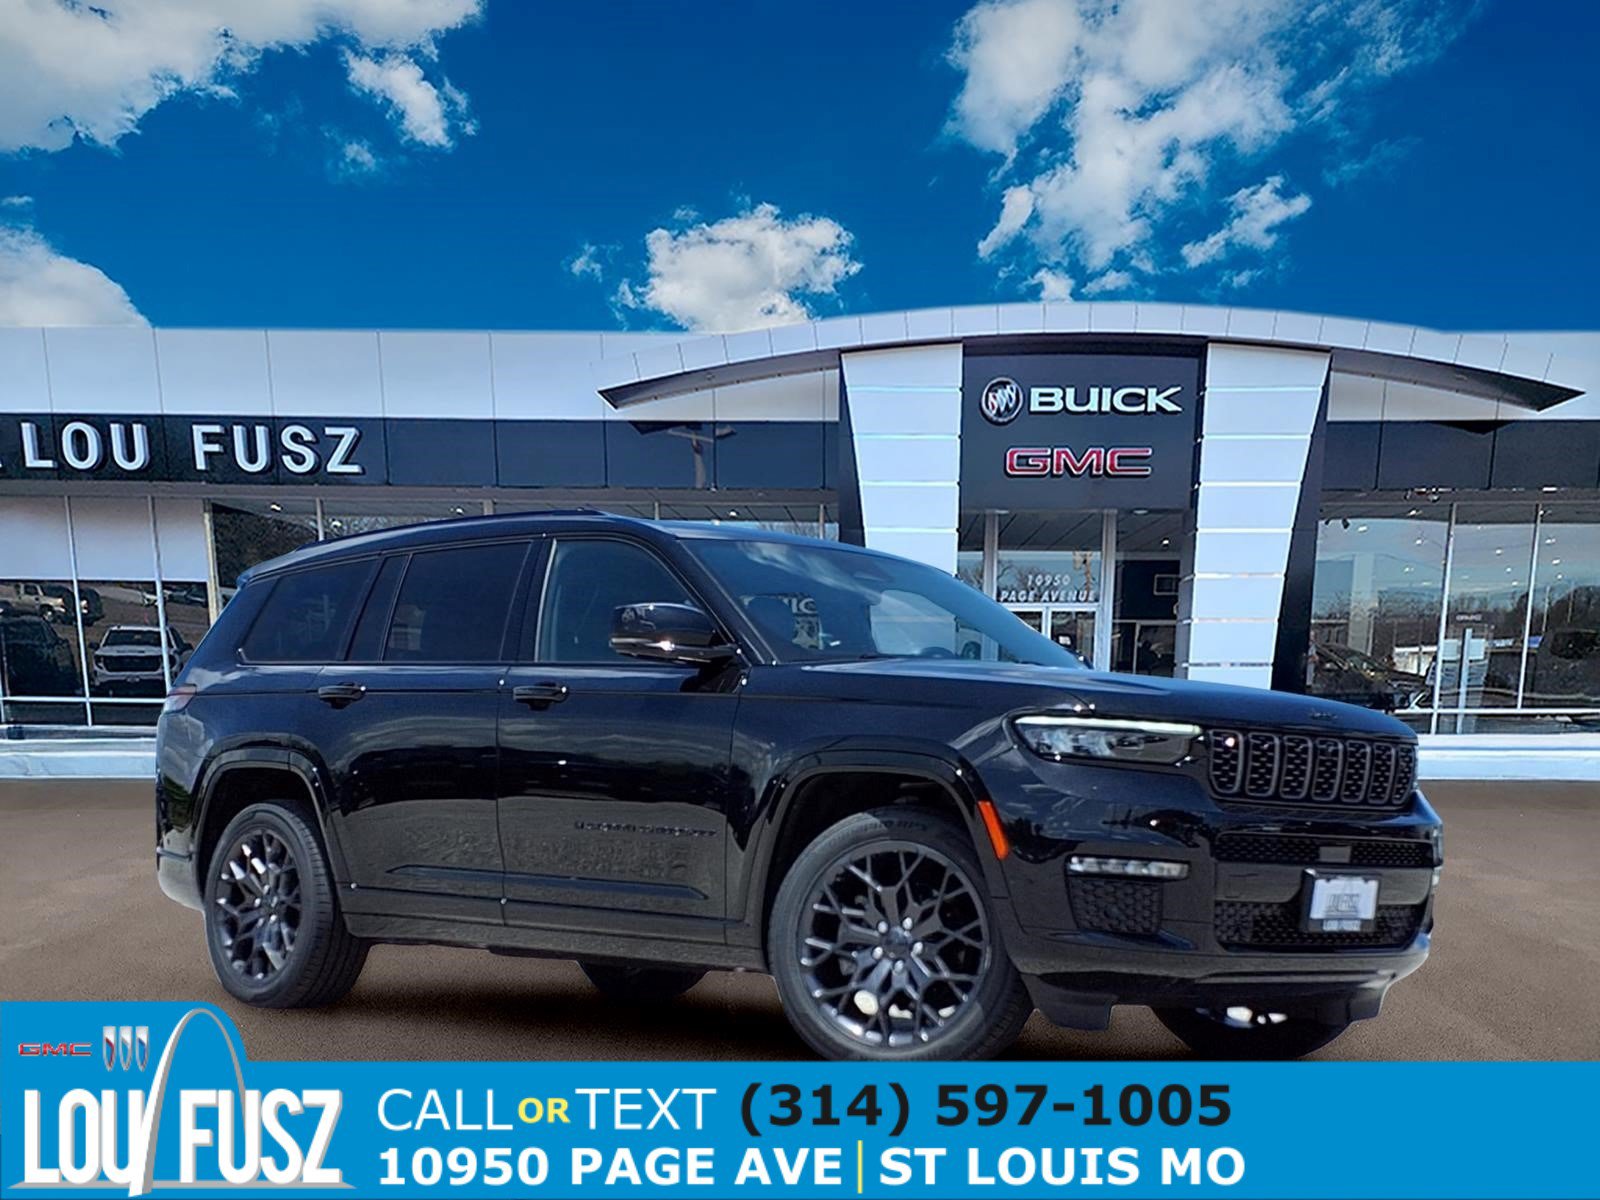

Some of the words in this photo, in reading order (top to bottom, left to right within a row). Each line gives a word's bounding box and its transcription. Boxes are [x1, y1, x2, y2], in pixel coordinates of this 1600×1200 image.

[1029, 386, 1182, 413] BUICK
[21, 420, 151, 472] LOU
[192, 423, 364, 475] FUSZ
[1005, 447, 1153, 477] GMC
[1027, 574, 1071, 586] 10950
[1000, 590, 1035, 602] PAGE
[1041, 590, 1095, 602] AVENUE
